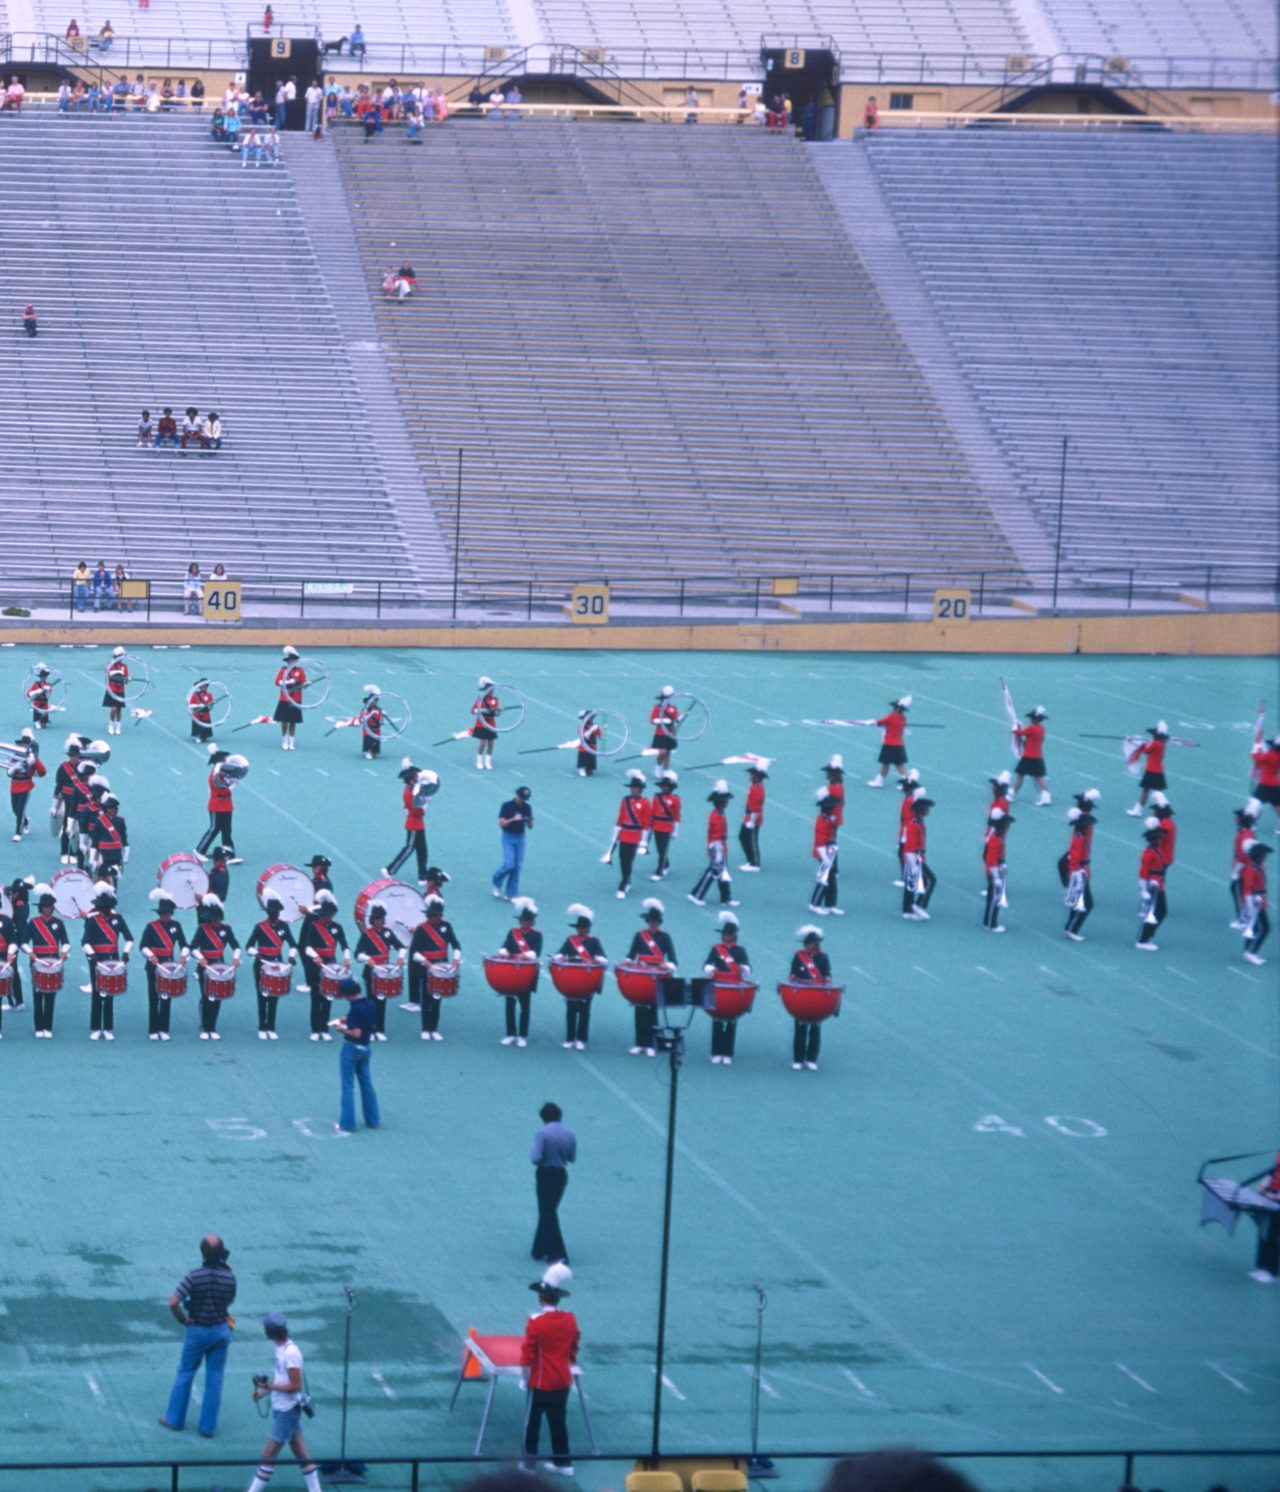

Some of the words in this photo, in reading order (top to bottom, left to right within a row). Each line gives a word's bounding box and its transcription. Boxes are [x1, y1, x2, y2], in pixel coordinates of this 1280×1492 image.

[277, 42, 286, 54] 9
[790, 52, 799, 64] 8
[207, 591, 236, 610] 40
[576, 595, 604, 615] 30
[938, 598, 966, 619] 20
